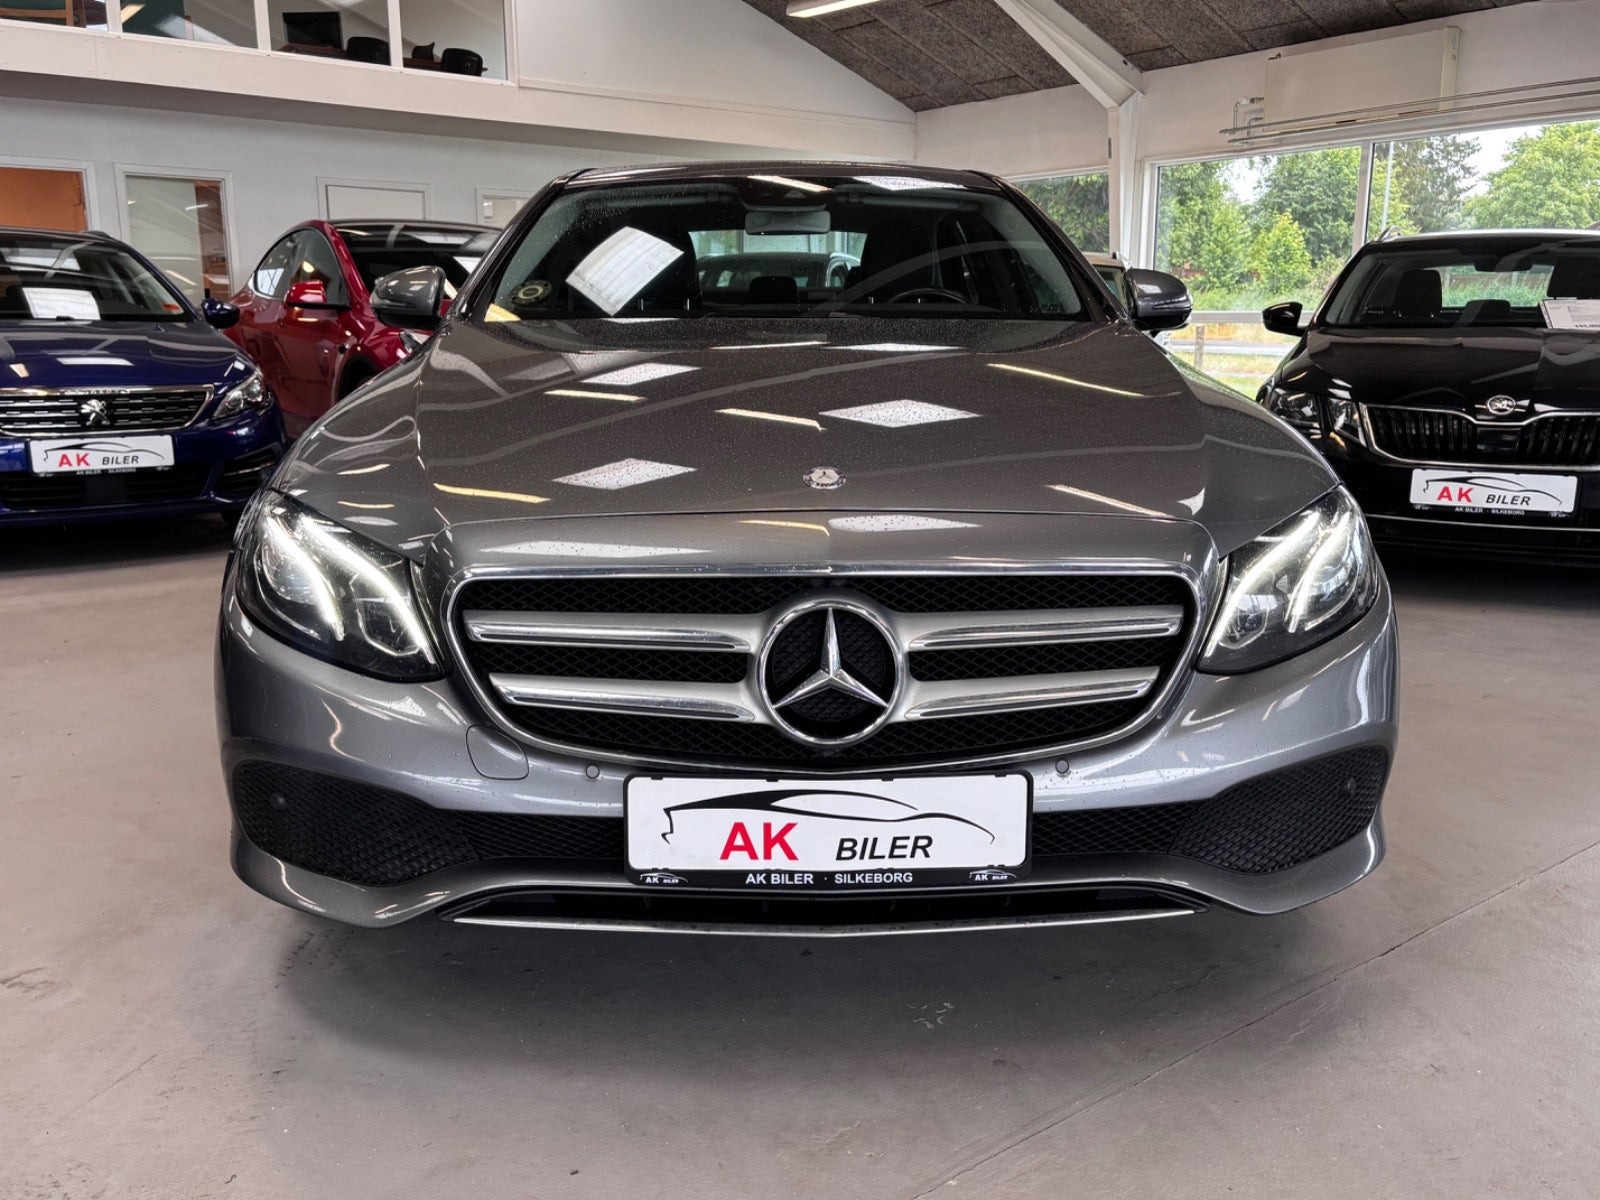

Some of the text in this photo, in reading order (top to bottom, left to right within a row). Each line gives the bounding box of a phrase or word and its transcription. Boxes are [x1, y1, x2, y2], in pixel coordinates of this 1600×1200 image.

[58, 453, 140, 468] AK BILER
[1437, 486, 1532, 506] AK BILER
[719, 821, 933, 862] AK BILER
[645, 876, 659, 884] AK
[745, 872, 913, 885] AK BILER SILKEBORG
